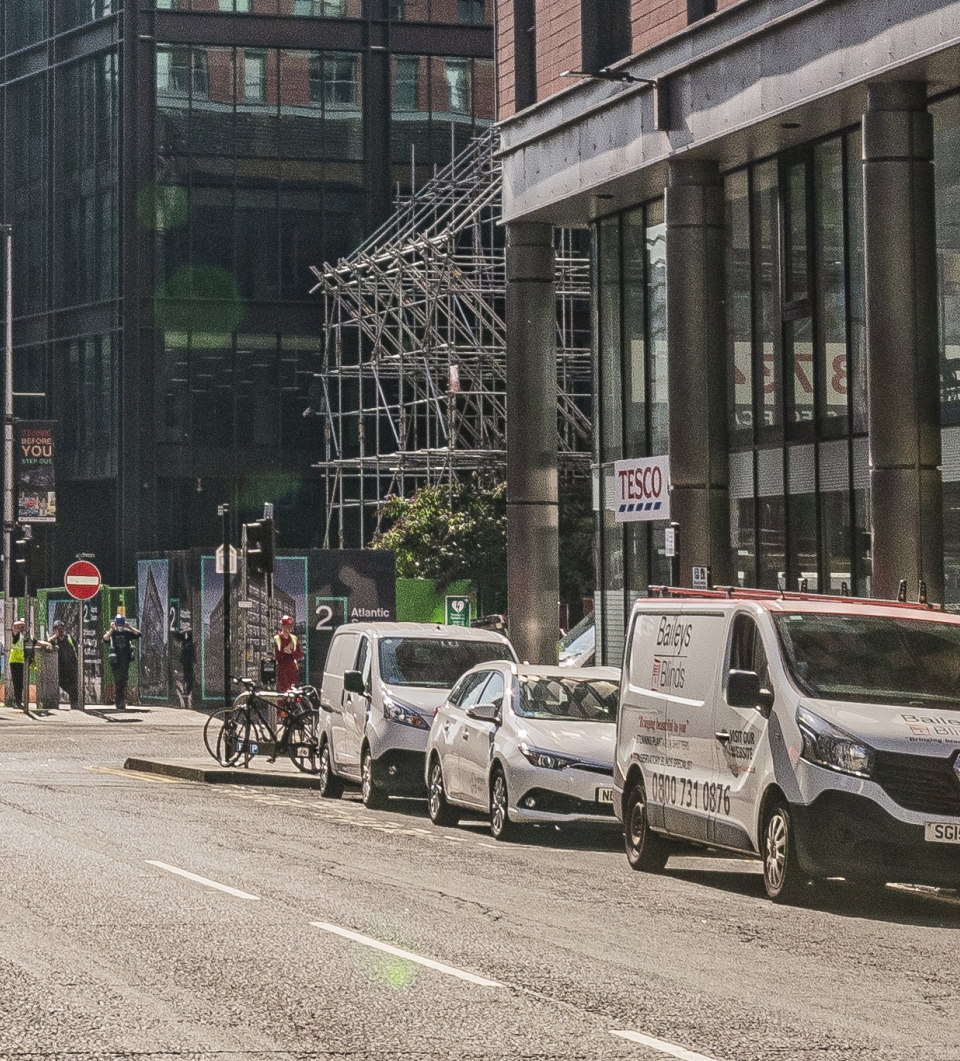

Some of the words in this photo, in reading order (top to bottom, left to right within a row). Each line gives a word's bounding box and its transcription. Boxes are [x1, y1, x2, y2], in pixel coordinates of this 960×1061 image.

[21, 445, 52, 457] YOU
[618, 466, 662, 500] TESCO
[315, 604, 333, 631] 2
[350, 607, 390, 618] Atlantic
[656, 616, 692, 655] Baileys
[660, 660, 685, 689] Blinds
[743, 731, 755, 745] OUR
[652, 772, 676, 805] 0800
[680, 778, 698, 809] 731
[703, 781, 731, 816] 0876
[934, 824, 960, 840] SG1
